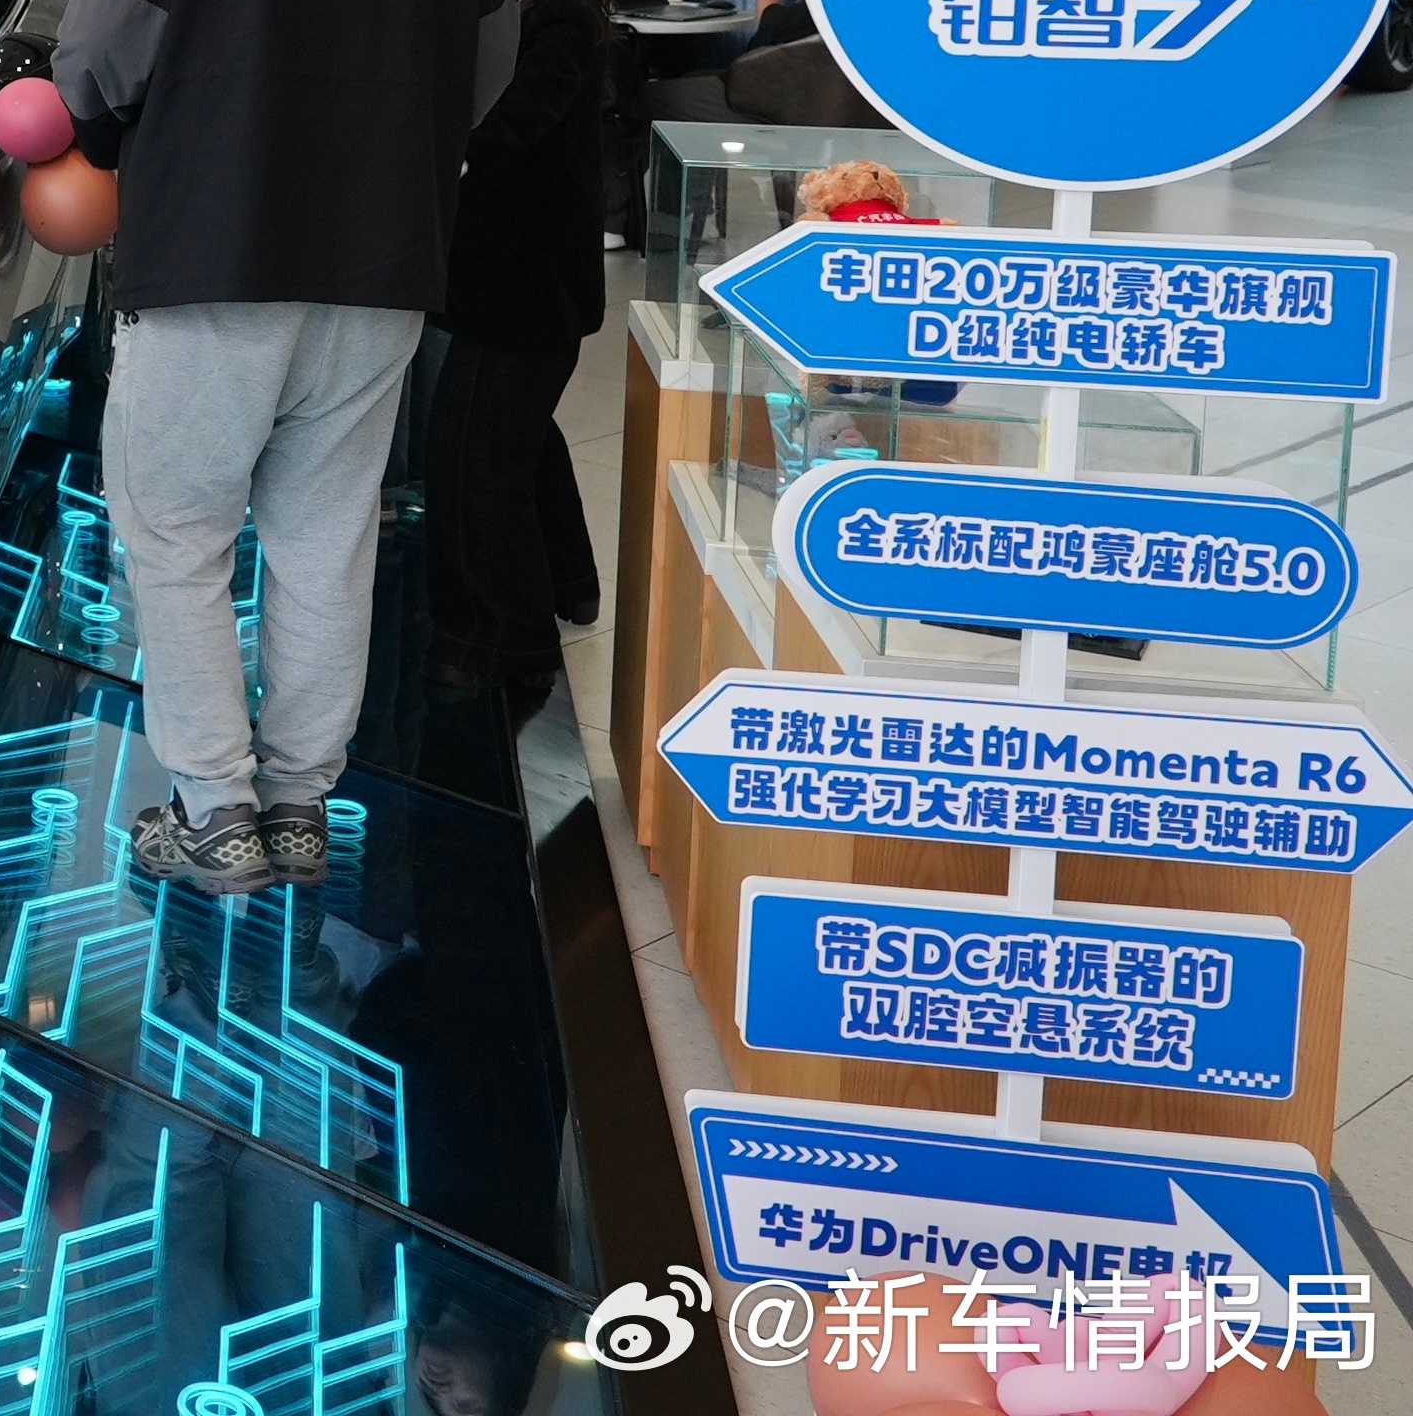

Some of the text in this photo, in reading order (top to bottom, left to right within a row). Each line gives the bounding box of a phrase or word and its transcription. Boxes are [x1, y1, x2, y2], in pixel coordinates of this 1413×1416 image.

[822, 250, 1332, 323] 丰田20万级豪华旗舰
[911, 312, 1224, 372] D级纯电轿车
[841, 514, 1323, 592] 全系标配鸿蒙座舱5.0
[730, 706, 1368, 794] 带激光雷达的Momenta R6
[730, 767, 1356, 859] 强化学习大模型智能驾驶辅助
[818, 920, 1229, 1004] 带SDC减振器的
[845, 986, 1195, 1070] 双腔空悬系统
